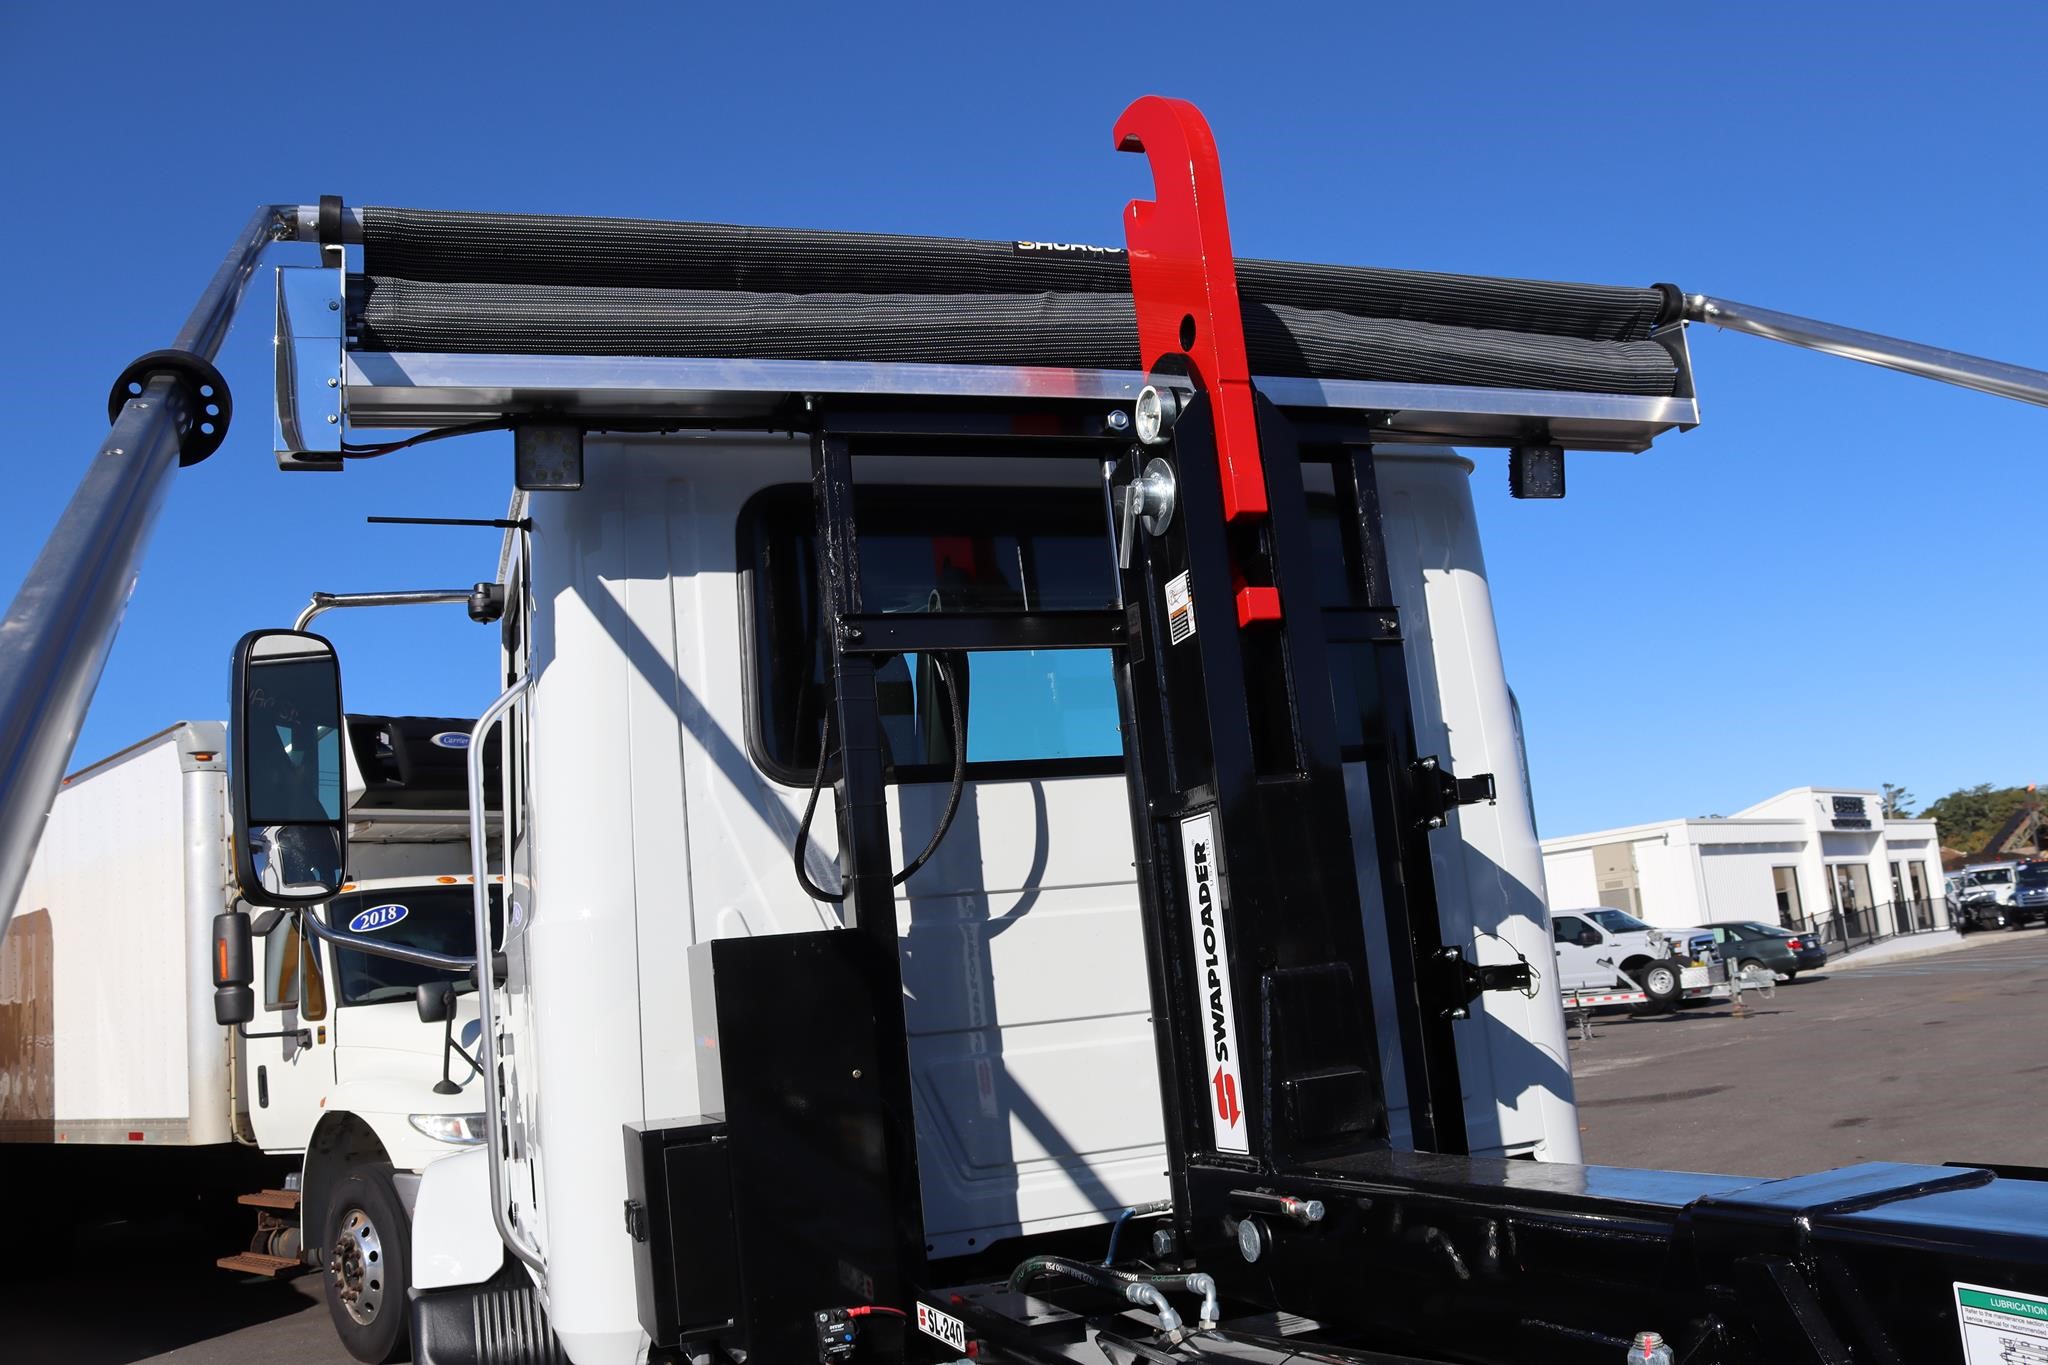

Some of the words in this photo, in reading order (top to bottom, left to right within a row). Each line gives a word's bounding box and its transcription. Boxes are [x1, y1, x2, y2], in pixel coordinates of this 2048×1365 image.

[360, 906, 397, 930] 2018
[1194, 841, 1229, 1062] SWAPLOADER
[1990, 1298, 2048, 1316] LUBRICATION
[928, 1310, 963, 1347] SL-240
